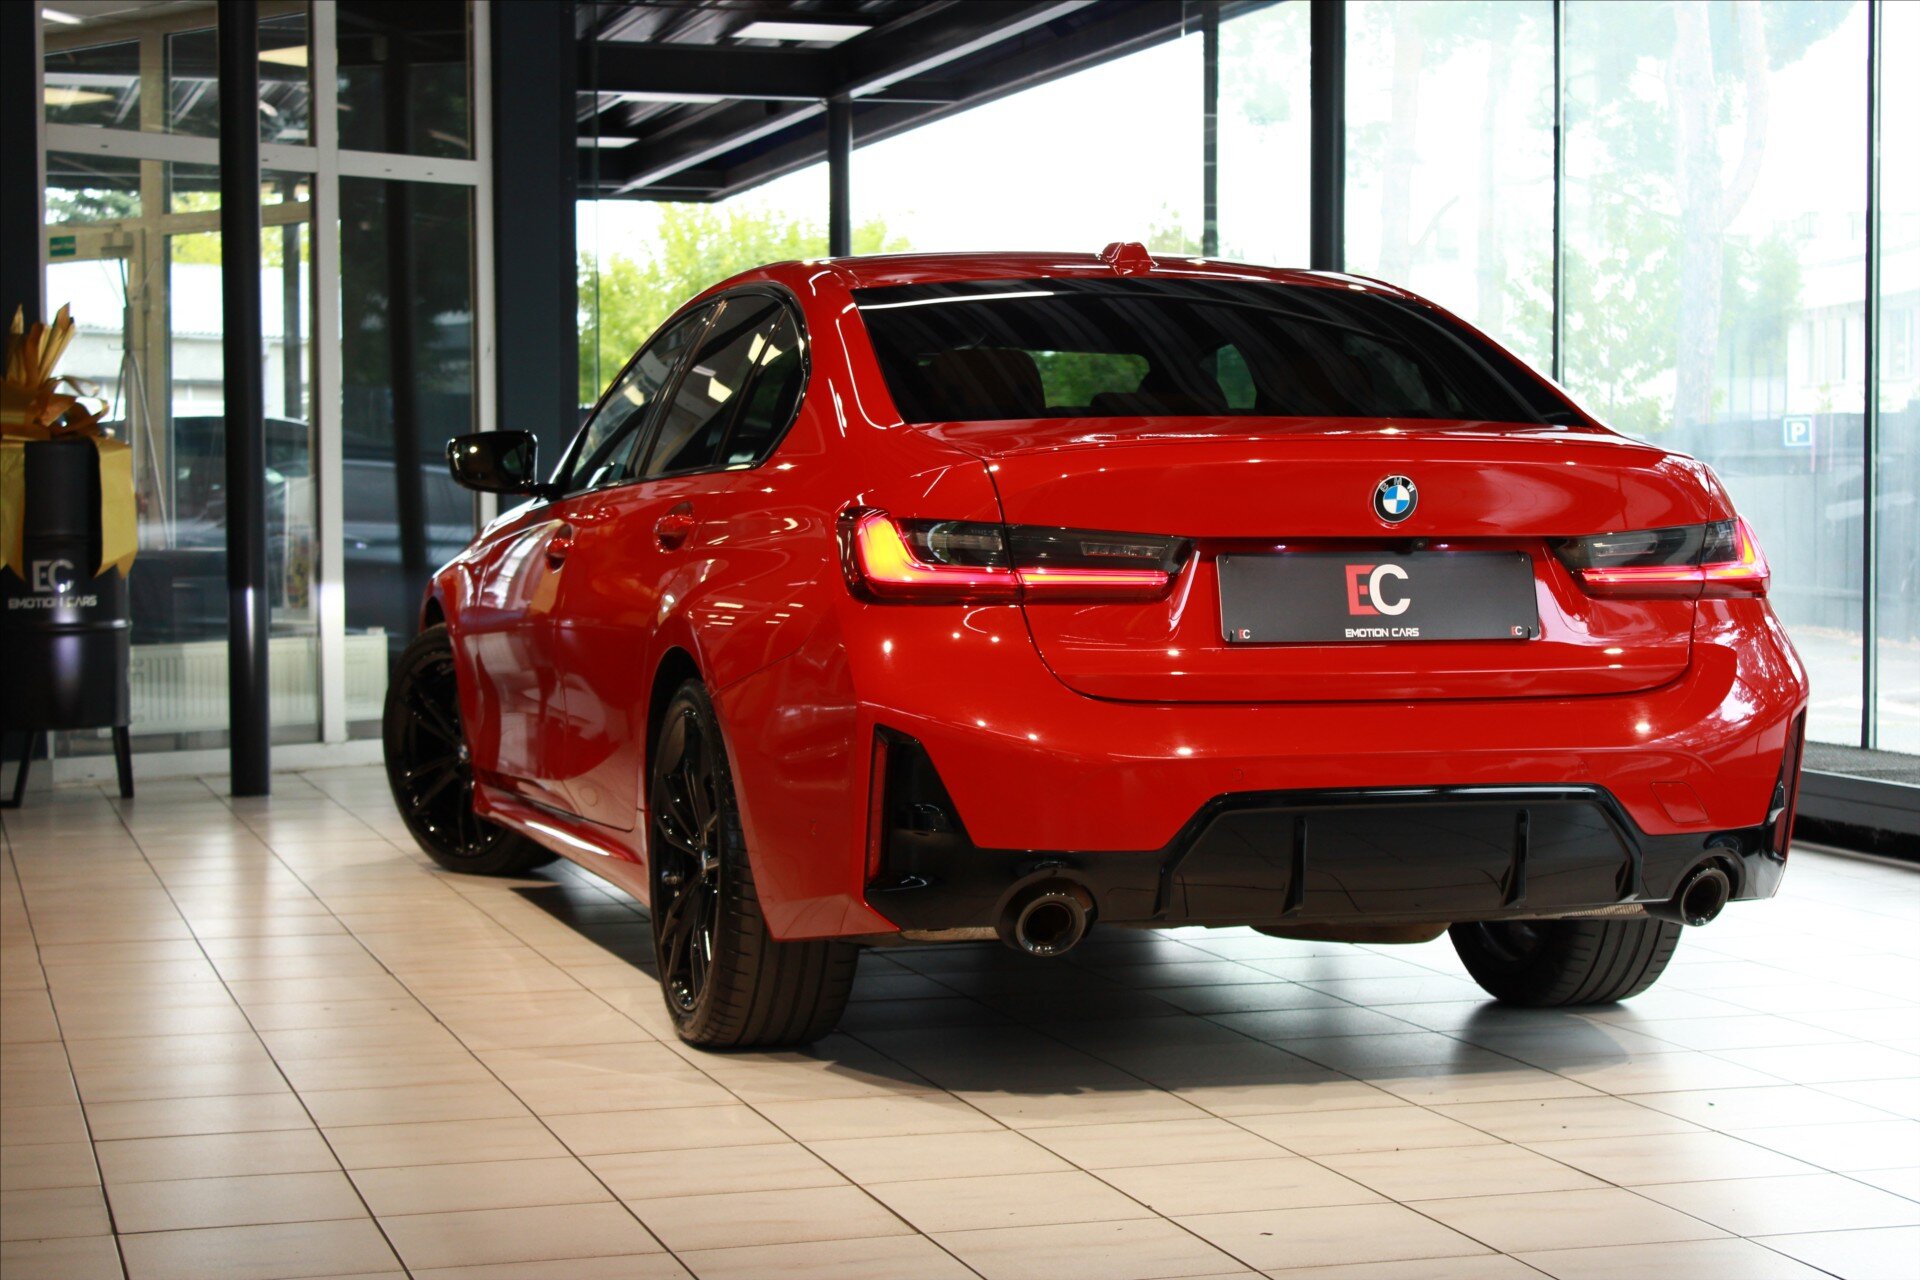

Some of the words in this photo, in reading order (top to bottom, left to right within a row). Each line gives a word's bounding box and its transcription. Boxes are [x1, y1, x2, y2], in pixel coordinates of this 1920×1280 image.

[1791, 422, 1806, 442] P
[1380, 477, 1415, 493] BMW
[32, 559, 75, 593] EC
[1345, 564, 1411, 616] EC
[66, 594, 98, 608] CARS
[1345, 628, 1389, 638] EMOTION
[1391, 627, 1420, 637] CARS
